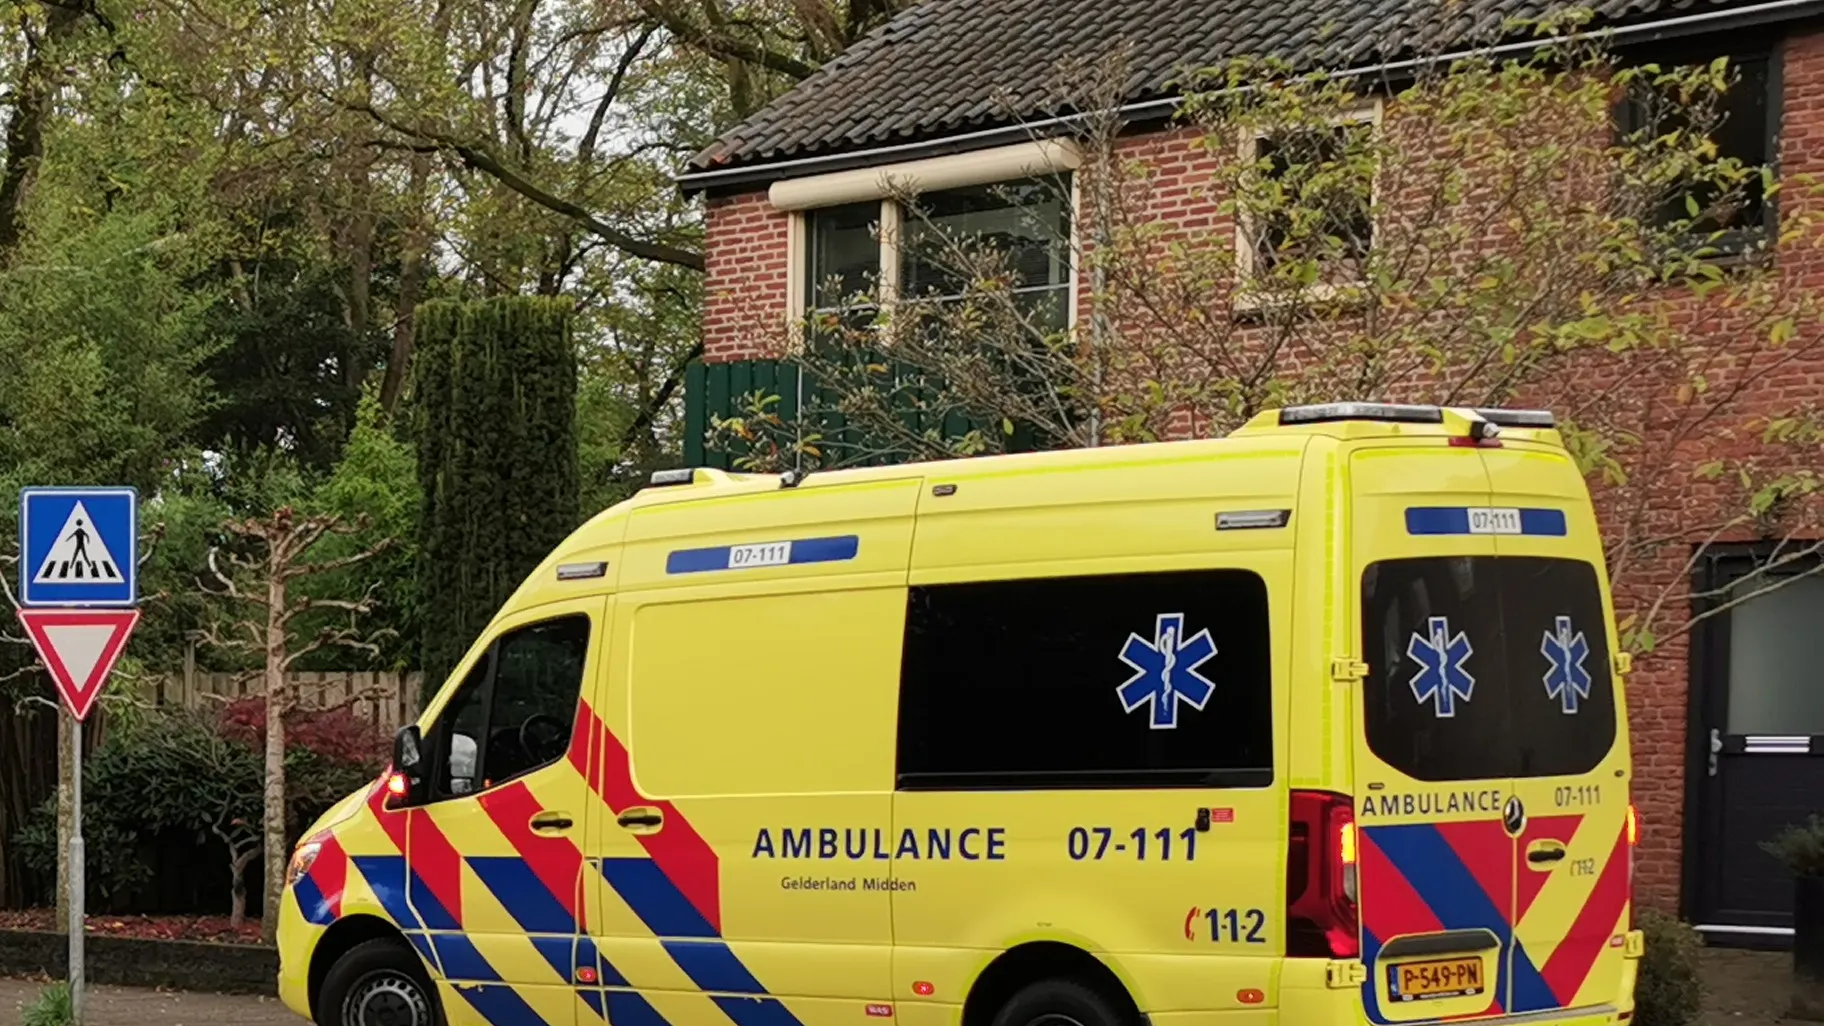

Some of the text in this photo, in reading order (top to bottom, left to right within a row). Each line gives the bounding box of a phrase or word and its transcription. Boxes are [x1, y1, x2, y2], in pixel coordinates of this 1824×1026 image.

[1472, 512, 1516, 528] 07-111
[734, 546, 785, 564] 07-111
[1361, 785, 1601, 817] AMBULANCE 07-111
[752, 827, 1196, 860] AMBULANCE 07-111
[781, 877, 916, 891] Gelderland Midden
[1404, 963, 1478, 990] P-549-PN
